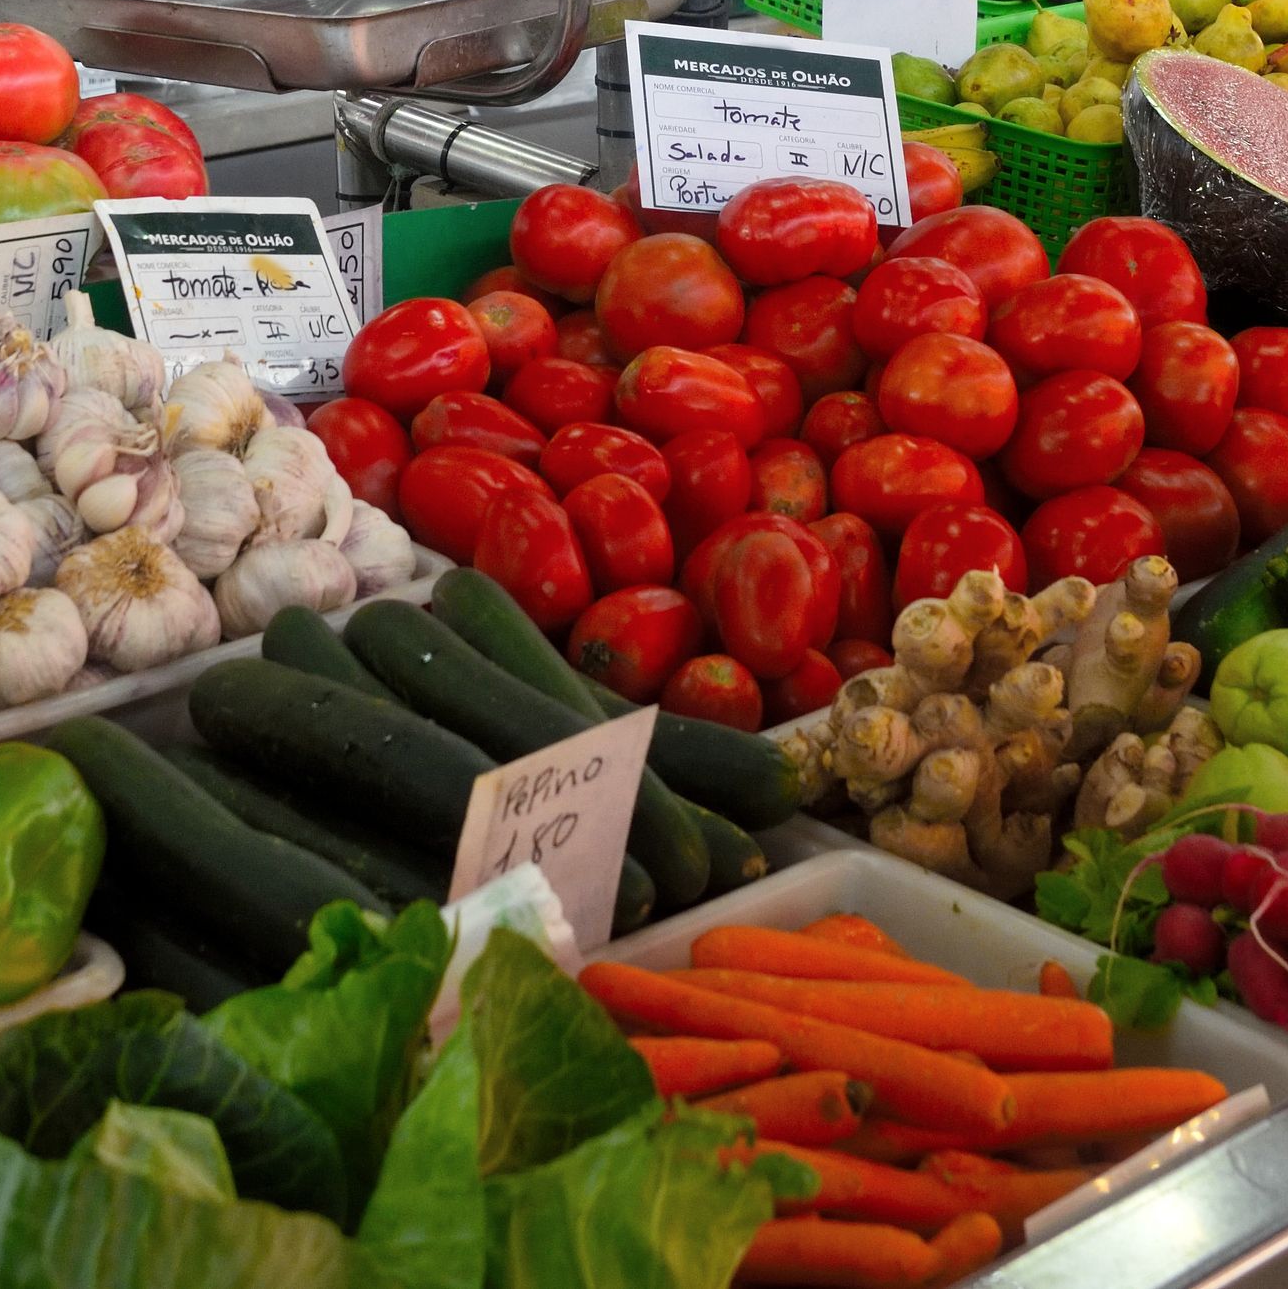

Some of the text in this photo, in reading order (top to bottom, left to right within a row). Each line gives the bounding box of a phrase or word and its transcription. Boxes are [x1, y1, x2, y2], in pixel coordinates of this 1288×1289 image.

[674, 59, 851, 88] MERCADOS DE OLHÃO
[740, 76, 796, 88] DESDE 1916
[653, 83, 716, 95] NOME COMERCIAL
[713, 100, 801, 132] tomate
[659, 124, 863, 151] VARIEDADE CATEGORIA CALIBRE
[662, 167, 691, 176] ORIGEM
[789, 151, 809, 167] II
[843, 149, 885, 178] N/C
[149, 233, 294, 247] MERCADOS DE OLHÃO
[1, 274, 10, 305] CALIBRE
